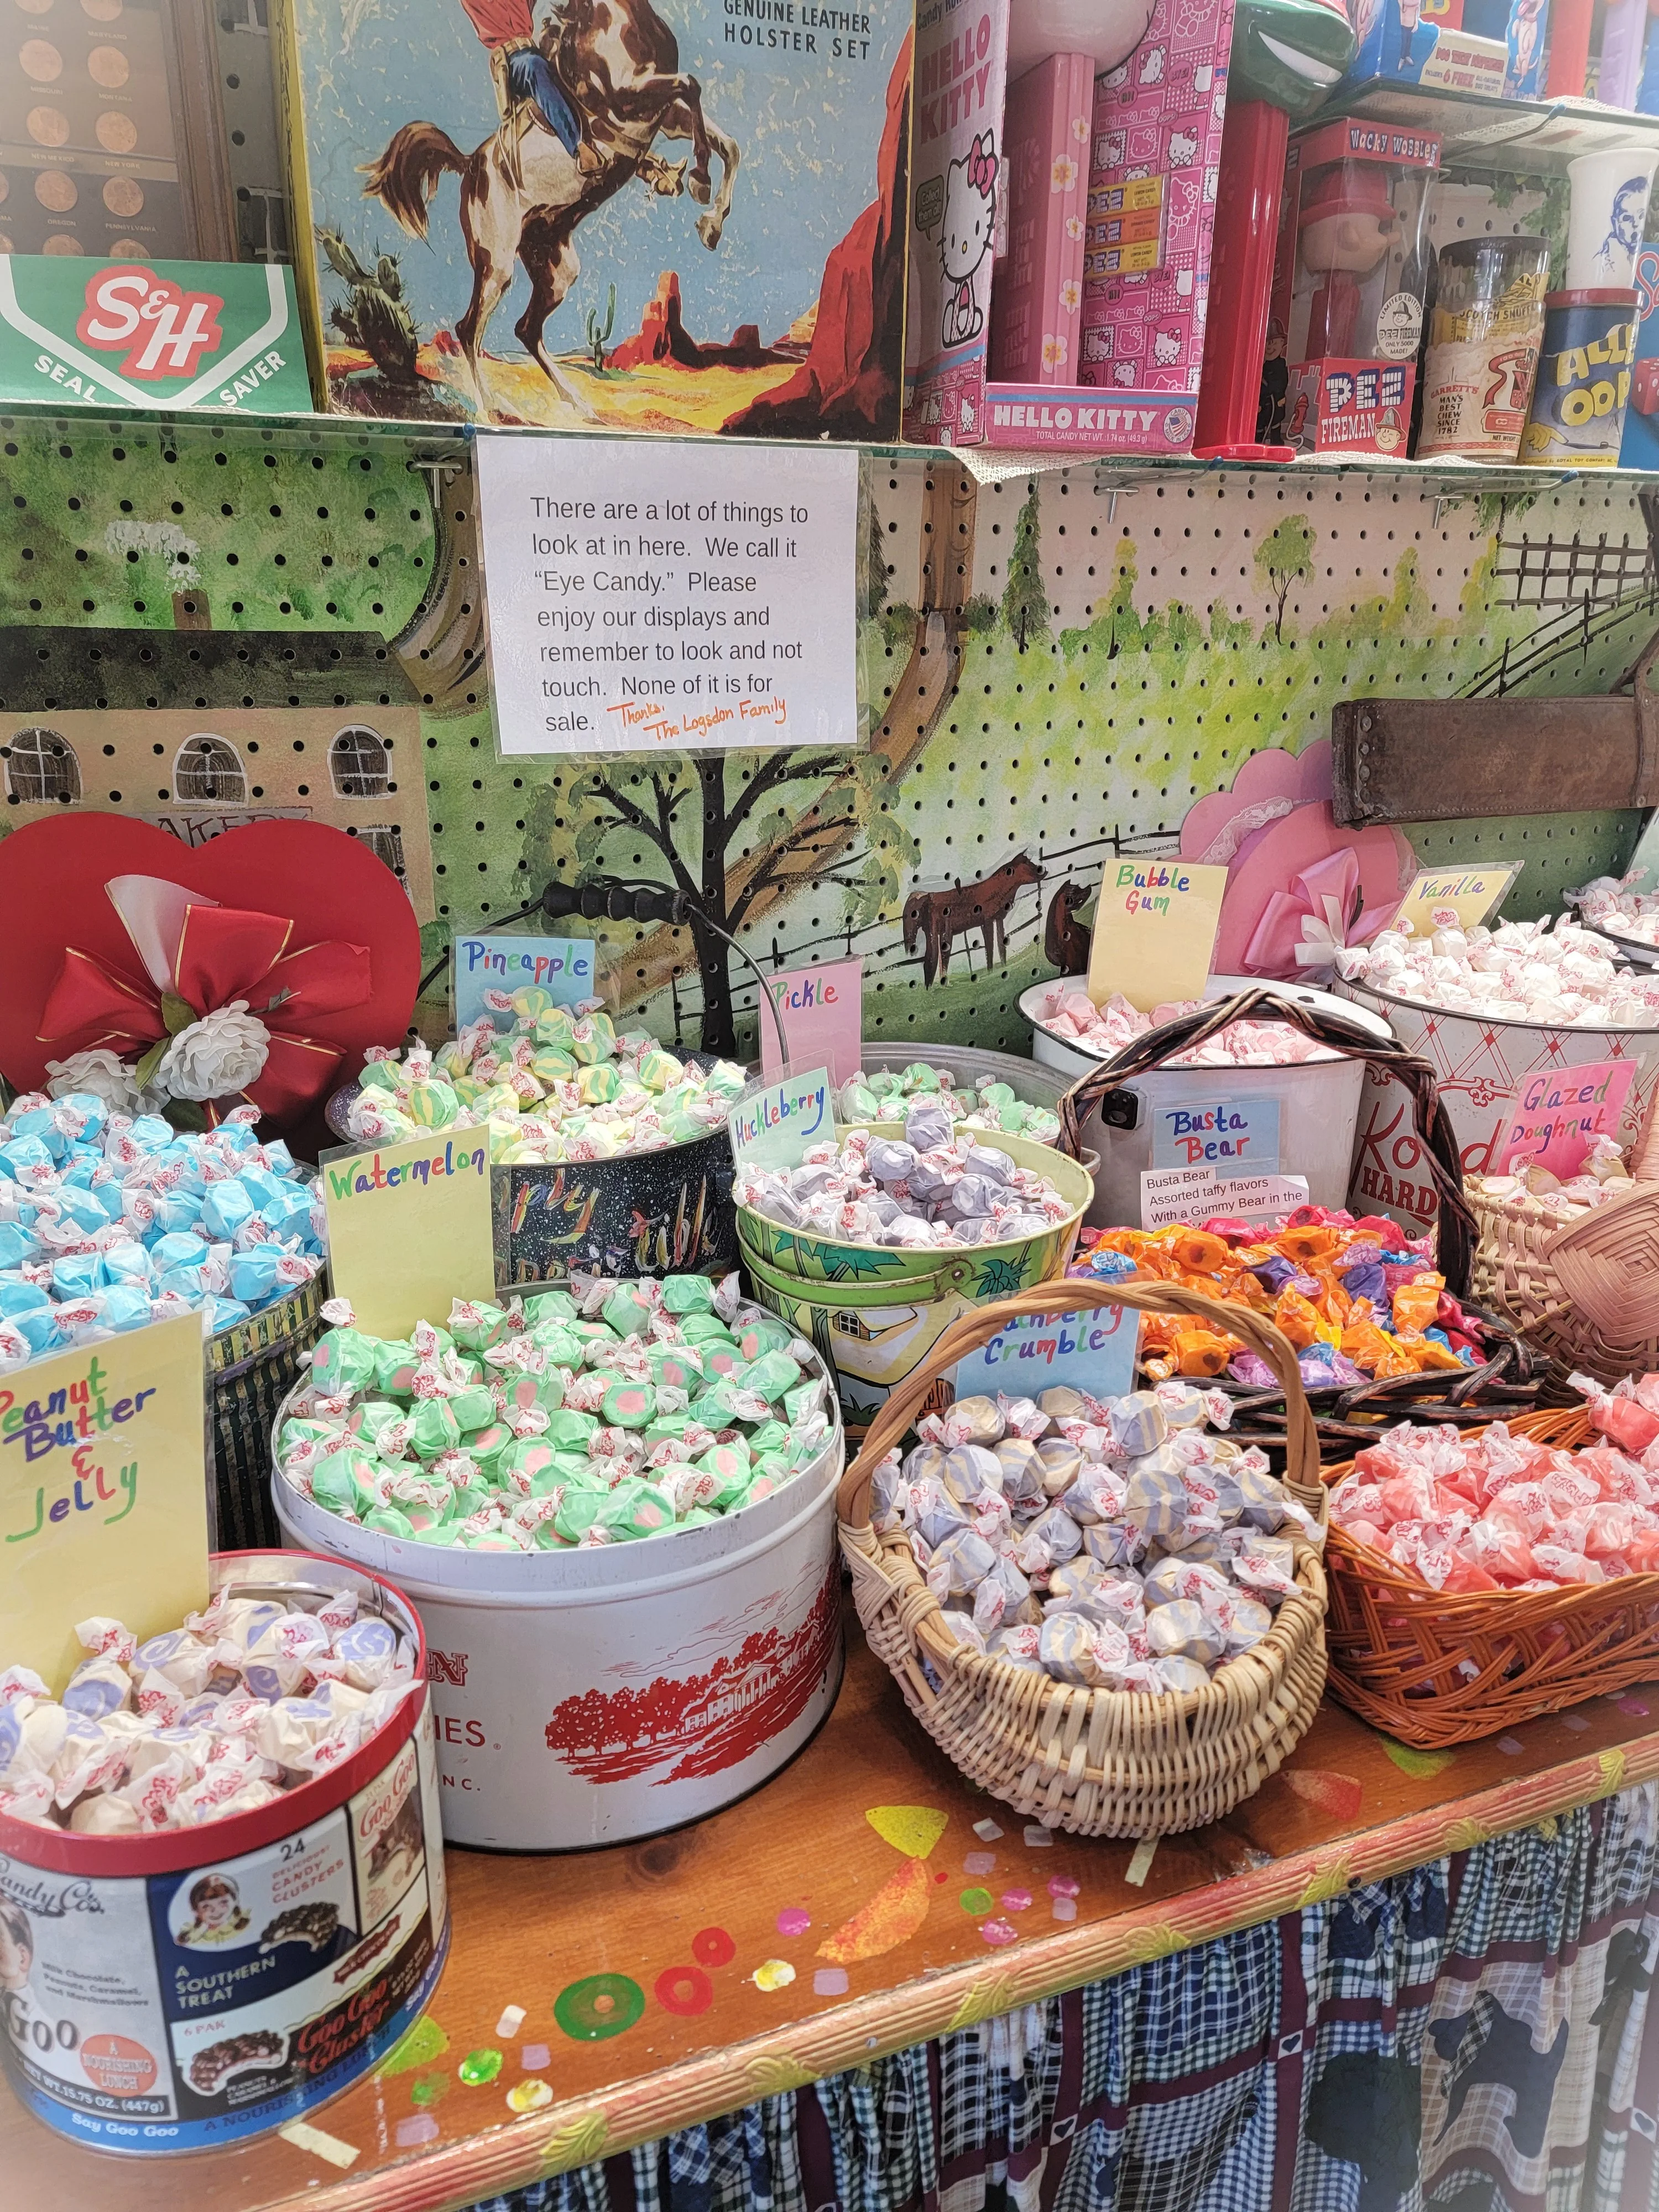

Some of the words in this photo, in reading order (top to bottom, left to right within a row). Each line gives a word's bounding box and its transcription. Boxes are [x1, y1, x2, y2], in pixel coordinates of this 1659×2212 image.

[724, 0, 794, 23] GENUINE
[801, 6, 872, 34] LEATHER
[87, 30, 127, 40] MARYLAND
[724, 22, 817, 54] HOLSTER
[832, 38, 871, 60] SET
[921, 13, 991, 98] HELLO
[30, 86, 64, 96] MISSOURI
[98, 92, 133, 102] MONTANA
[920, 60, 992, 144] KITTY
[48, 154, 75, 163] MEXICO
[47, 218, 76, 227] OREGON
[105, 223, 157, 232] PENNSYLVANIA
[1380, 295, 1402, 320] LIMITED
[1405, 294, 1422, 318] EDITION
[34, 354, 96, 403] SEAL
[218, 351, 286, 408] SAVER
[1326, 365, 1406, 414] PEZ
[1431, 384, 1479, 399] GARRETT'S
[1170, 408, 1189, 416] CANDY
[1439, 394, 1464, 404] MAN'S
[1439, 403, 1462, 412] BEST
[994, 405, 1073, 429] HELLO
[1077, 408, 1157, 431] KITTY
[1321, 413, 1376, 444] FIREMAN
[1438, 411, 1462, 420] CHEW
[1438, 419, 1460, 427] SINCE
[1036, 430, 1056, 440] TOTAL
[1056, 431, 1078, 441] CANDY
[1079, 433, 1092, 441] NET
[1438, 426, 1458, 435] 1782
[530, 497, 596, 520] There
[604, 503, 638, 520] are
[646, 504, 659, 520] a
[665, 500, 691, 521] lot
[698, 500, 717, 521] of
[723, 502, 783, 527] things
[790, 504, 808, 523] to
[533, 534, 577, 555] look
[586, 536, 606, 556] at
[613, 536, 631, 556] in
[639, 535, 691, 556] here.
[705, 536, 739, 556] We
[746, 537, 778, 557] call
[786, 538, 797, 557] it
[688, 572, 757, 591] Please
[538, 607, 594, 631] enjoy
[603, 611, 636, 626] our
[644, 607, 727, 630] displays
[733, 606, 770, 626] and
[540, 642, 649, 661] remember
[656, 643, 674, 661] to
[681, 640, 723, 660] look
[729, 640, 765, 660] and
[773, 641, 802, 659] not
[542, 677, 607, 697] touch.
[622, 676, 676, 695] None
[683, 675, 702, 694] of
[708, 675, 719, 693] it
[726, 675, 741, 693] is
[748, 674, 773, 692] for
[545, 711, 594, 731] sale.
[643, 721, 680, 742] The
[683, 705, 734, 737] Logsdon
[739, 696, 787, 724] Family
[1116, 864, 1190, 892] Bubble
[1418, 874, 1486, 901] Vanilla
[1125, 890, 1171, 917] Gum
[461, 941, 588, 985] Pineapple
[771, 977, 839, 1010] Pickle
[1522, 1069, 1614, 1112] Glazed
[734, 1086, 825, 1150] Huckleberry
[1165, 1105, 1249, 1136] Busta
[1510, 1109, 1606, 1155] Doughnut
[1175, 1136, 1251, 1165] Bear
[328, 1141, 485, 1201] Watermelon
[1146, 1176, 1179, 1190] Busta
[1183, 1169, 1210, 1183] Bear
[1149, 1187, 1199, 1207] Assorted
[1202, 1184, 1227, 1197] taffy
[1230, 1178, 1269, 1192] flavors
[1360, 1165, 1438, 1216] HARD
[1151, 1211, 1177, 1224] With
[1180, 1210, 1188, 1218] a
[1191, 1201, 1235, 1217] Gummy
[1238, 1196, 1266, 1209] Bear
[1269, 1192, 1280, 1204] in
[1283, 1191, 1303, 1203] the
[984, 1325, 1106, 1365] Crumble
[3, 1387, 156, 1463] Butter
[5, 1460, 139, 1543] Jelly
[442, 1773, 481, 1792] NC.
[280, 1837, 306, 1863] 24
[272, 1860, 322, 1892] CANDY
[272, 1859, 345, 1905] CLUSTERS
[174, 1965, 190, 1979] A
[175, 1955, 276, 1995] SOUTHERN
[177, 1985, 234, 2010] TREAT
[196, 2020, 226, 2034] PAK
[109, 2041, 118, 2056] A
[82, 2052, 153, 2074] NOURISHING
[99, 2072, 139, 2090] LUNCH
[121, 2098, 165, 2114] (447g)
[71, 2112, 102, 2133] Say
[105, 2122, 139, 2137] Goo
[143, 2125, 179, 2137] Goo
[204, 2121, 217, 2131] A
